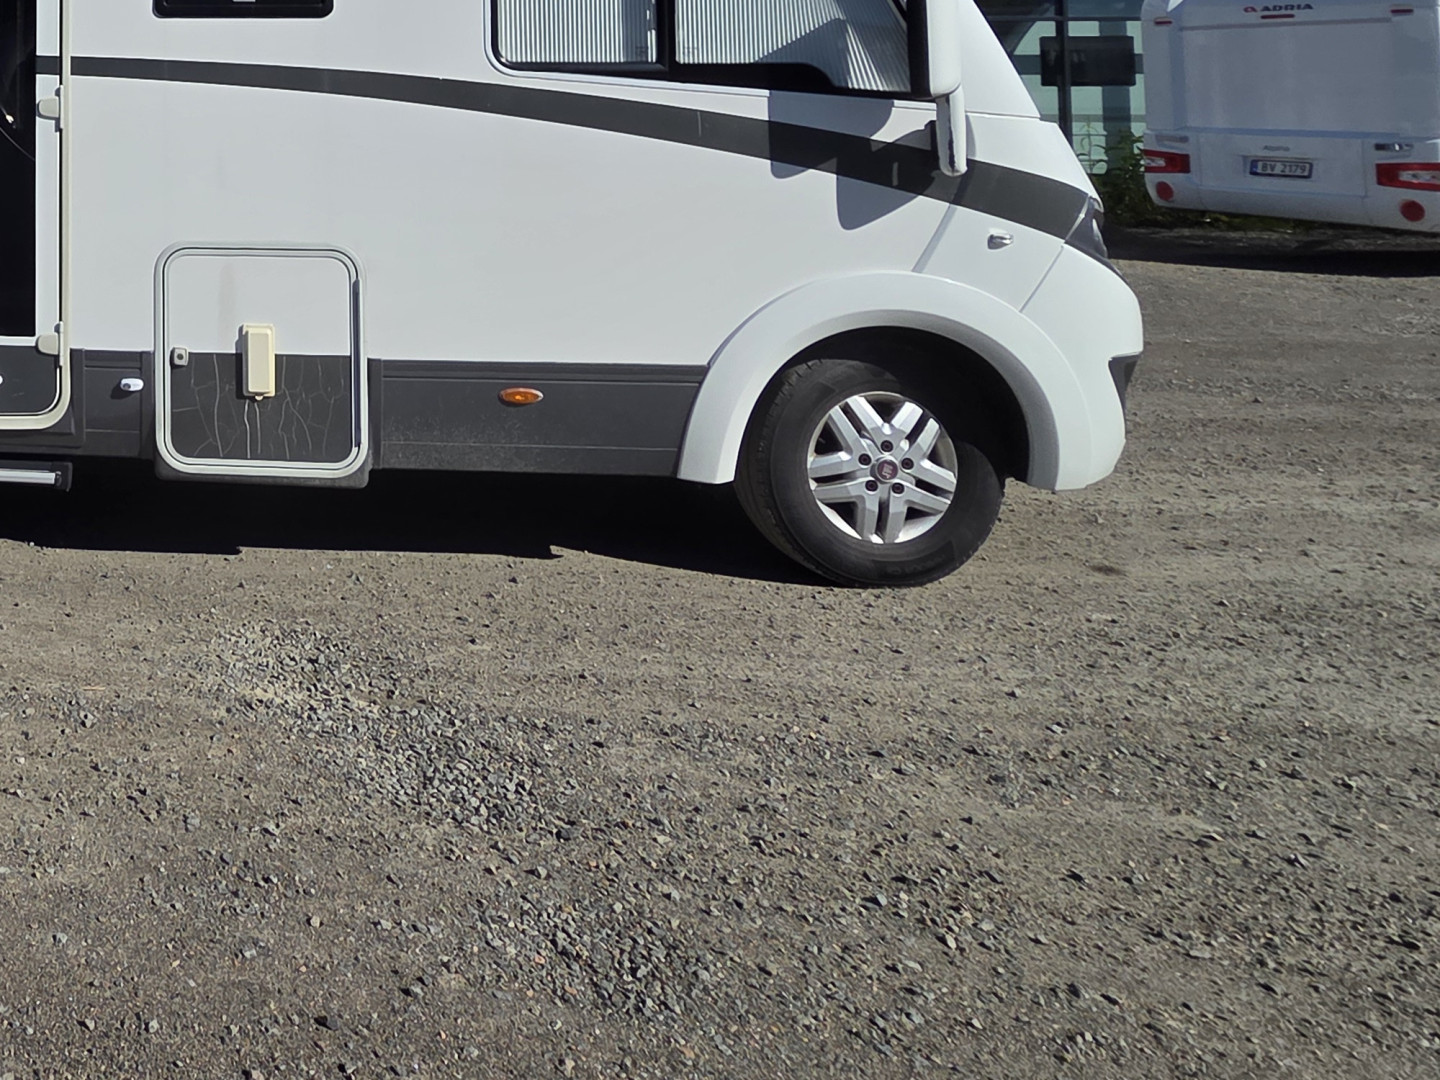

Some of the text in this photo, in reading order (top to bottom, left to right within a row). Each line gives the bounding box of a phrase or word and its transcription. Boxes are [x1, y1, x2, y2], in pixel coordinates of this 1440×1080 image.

[1261, 4, 1314, 12] ADRIA
[1261, 162, 1307, 174] BV 2179
